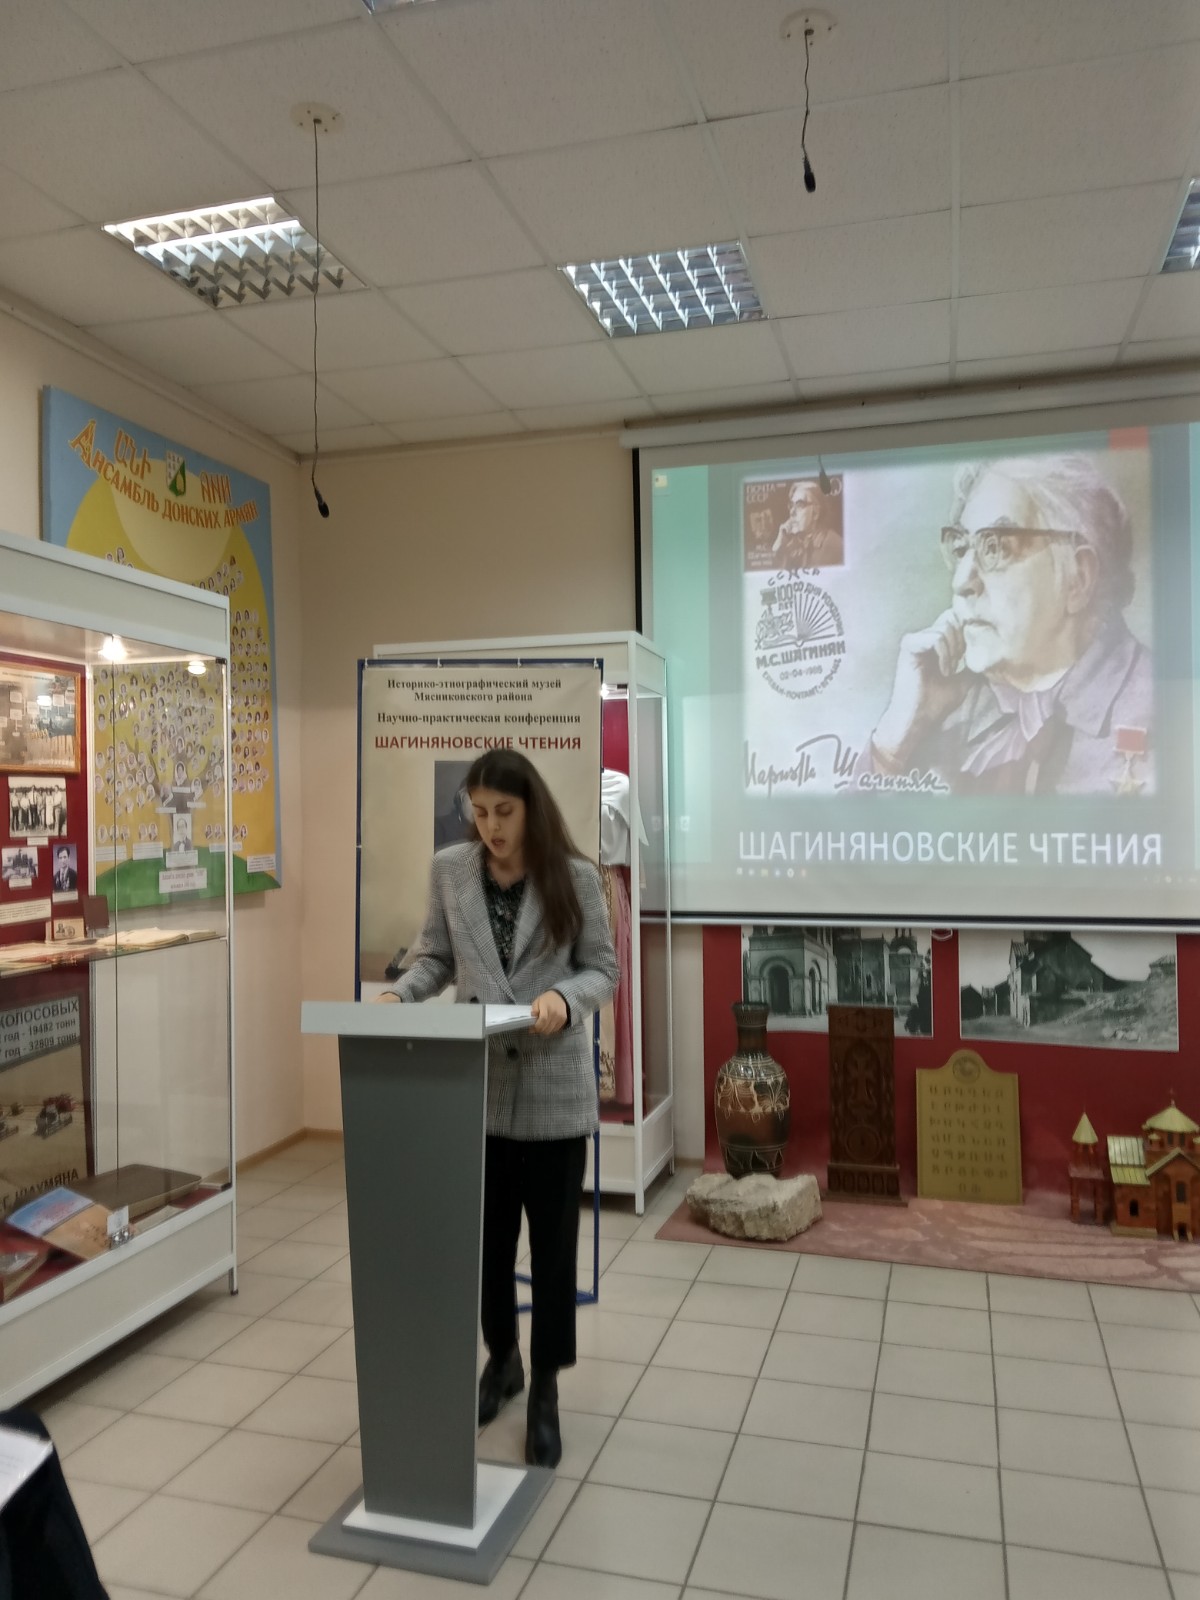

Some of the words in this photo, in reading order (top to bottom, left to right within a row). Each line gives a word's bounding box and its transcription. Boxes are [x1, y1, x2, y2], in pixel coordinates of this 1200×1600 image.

[162, 499, 222, 529] ДОНСКИХ
[223, 501, 259, 528] АРМЯН
[777, 583, 793, 602] 100
[387, 679, 529, 691] Историко-этнографический
[532, 679, 561, 691] музей
[414, 692, 493, 702] Мясниковского
[496, 692, 533, 703] района
[377, 712, 501, 724] Научно-практическая
[504, 713, 581, 725] конференция
[375, 736, 514, 749] ШАГИНЯНОВСКИЕ
[519, 736, 582, 750] ЧТЕНИЯ
[739, 830, 1018, 864] ШАГИНЯНОВСКИЕ
[1030, 832, 1162, 866] ЧТЕНИЯ
[4, 1032, 20, 1042] год
[56, 1018, 76, 1030] тонн
[5, 1047, 21, 1058] год
[57, 1033, 77, 1045] тонн
